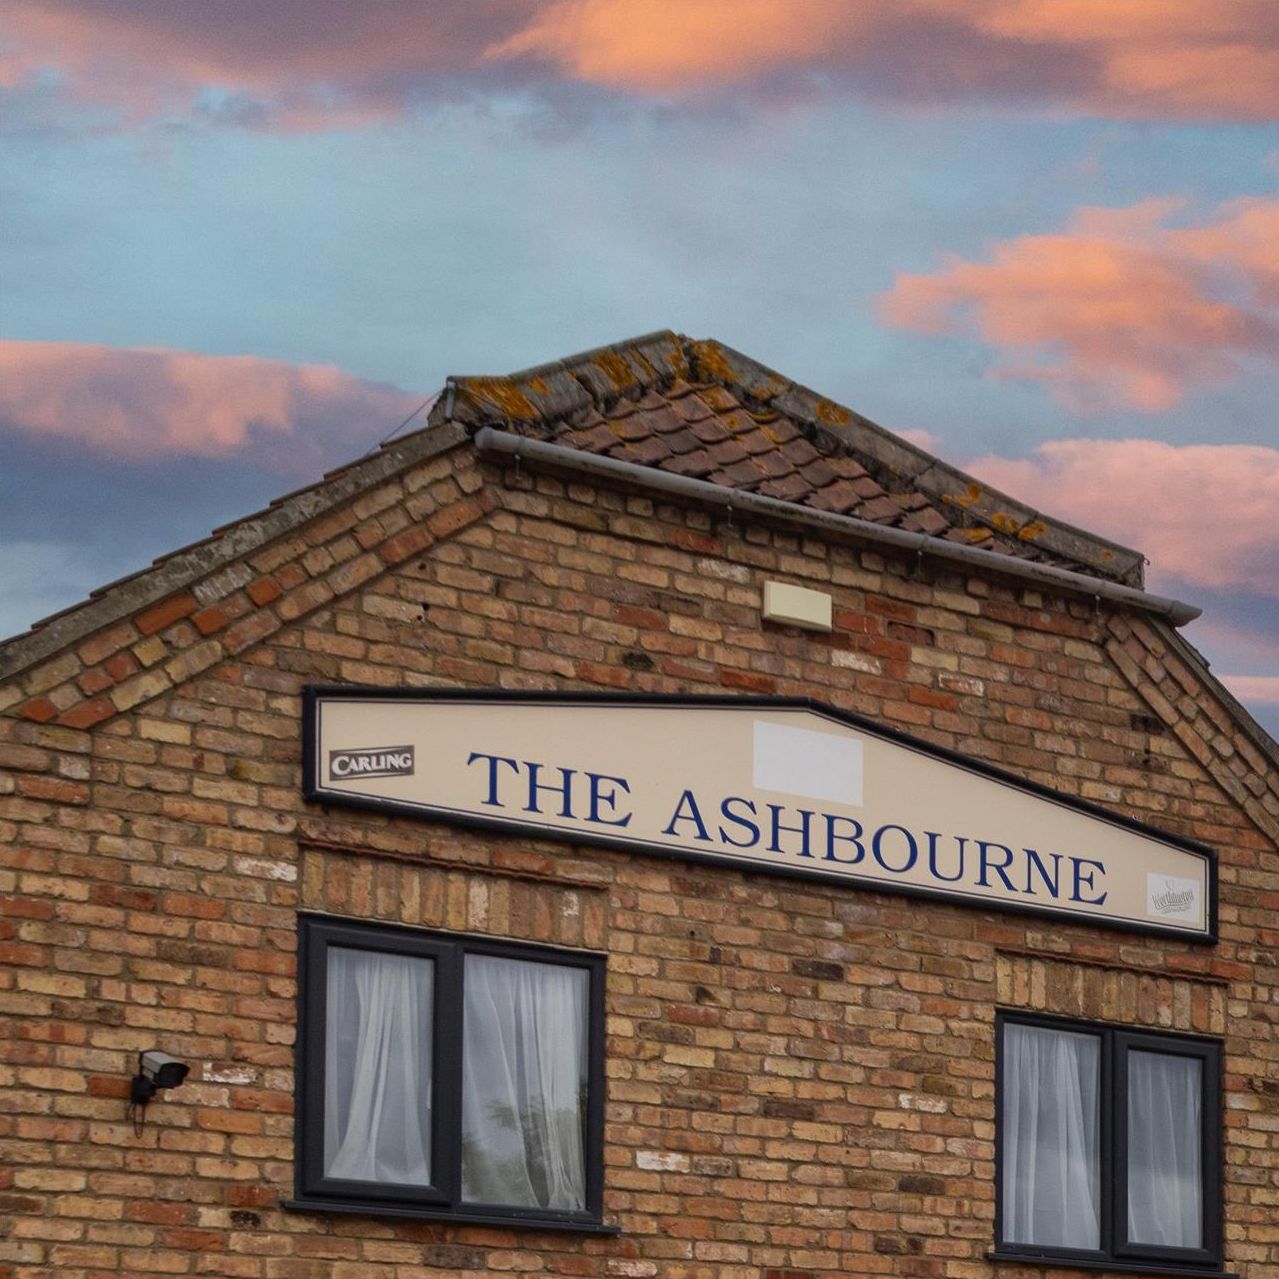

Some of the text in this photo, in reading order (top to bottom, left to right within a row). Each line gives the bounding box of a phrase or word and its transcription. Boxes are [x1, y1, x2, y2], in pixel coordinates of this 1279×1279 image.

[331, 752, 412, 776] CARLING
[467, 752, 1108, 906] THE ASHBOURNE
